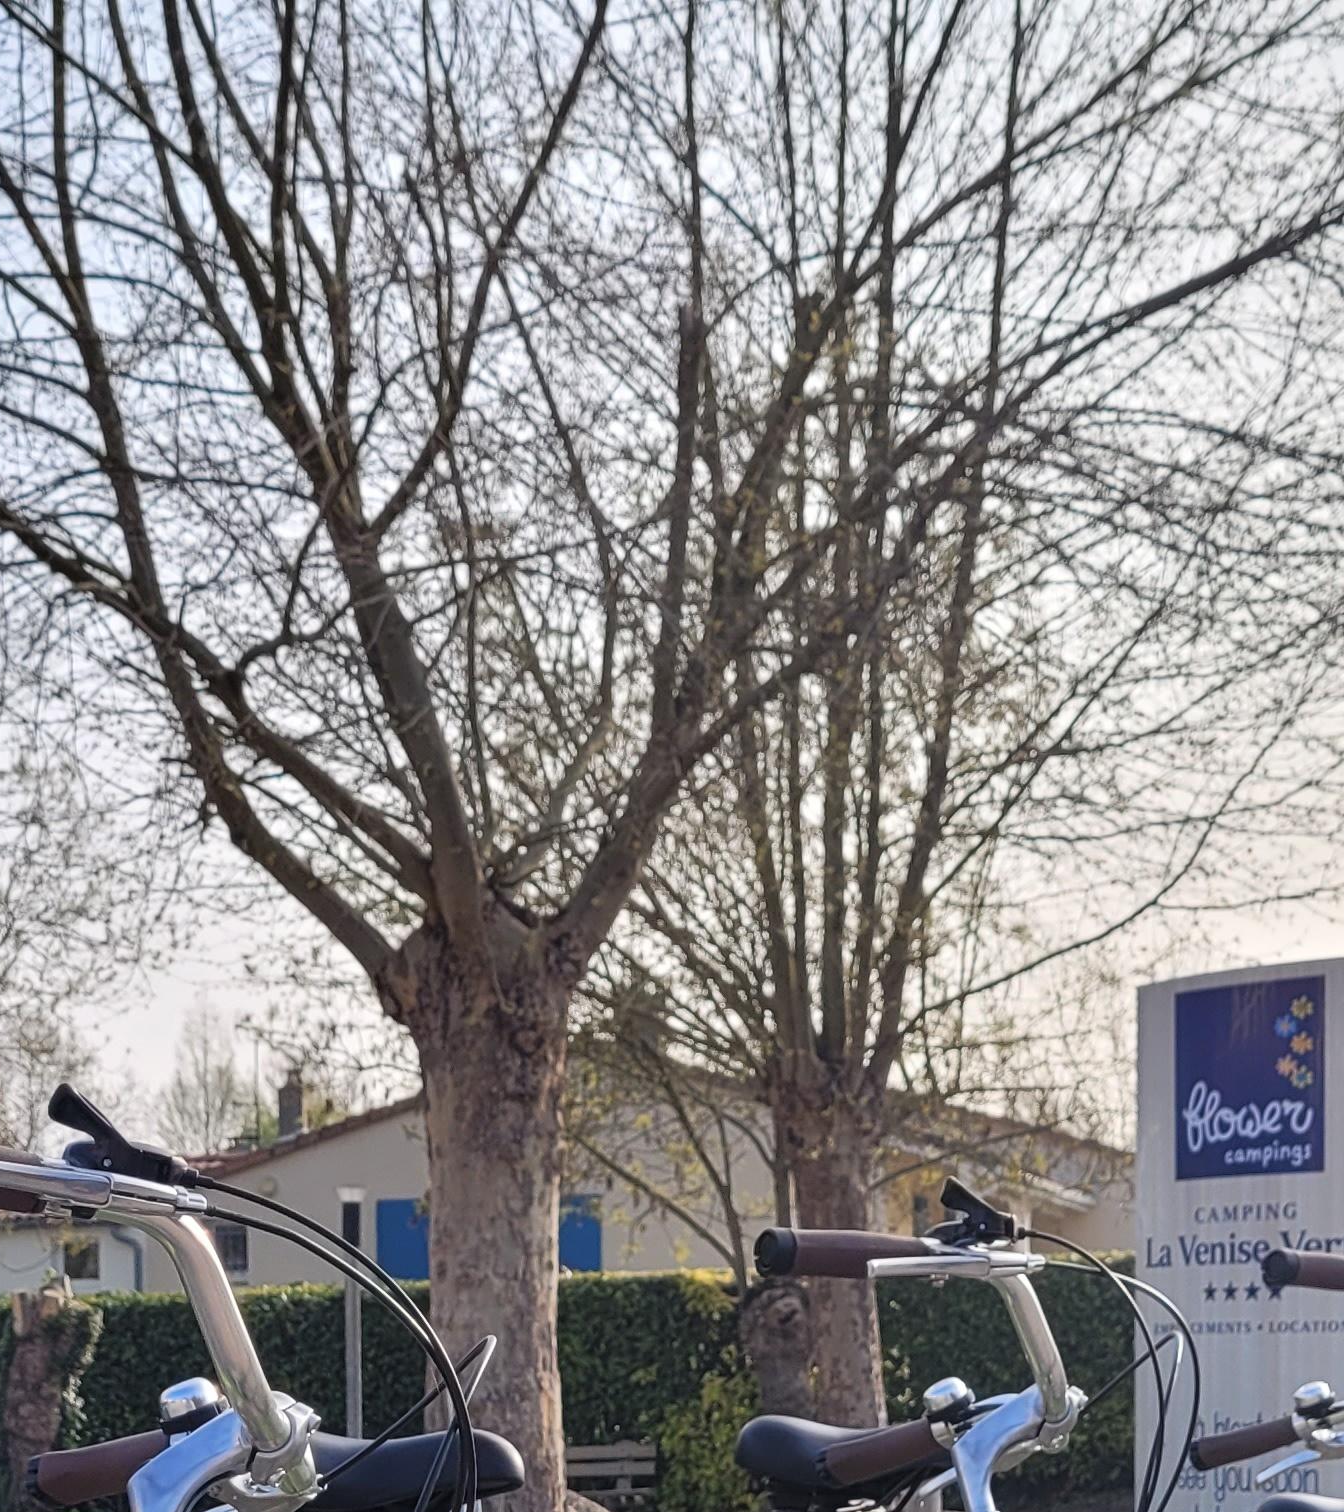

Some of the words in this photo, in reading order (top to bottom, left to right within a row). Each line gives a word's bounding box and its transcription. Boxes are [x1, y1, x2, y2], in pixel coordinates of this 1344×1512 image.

[1183, 1080, 1314, 1152] flower
[1224, 1140, 1313, 1167] campings
[1194, 1202, 1298, 1224] CAMPING
[1146, 1236, 1172, 1268] La
[1178, 1232, 1270, 1266] Venise
[1214, 1466, 1252, 1502] you
